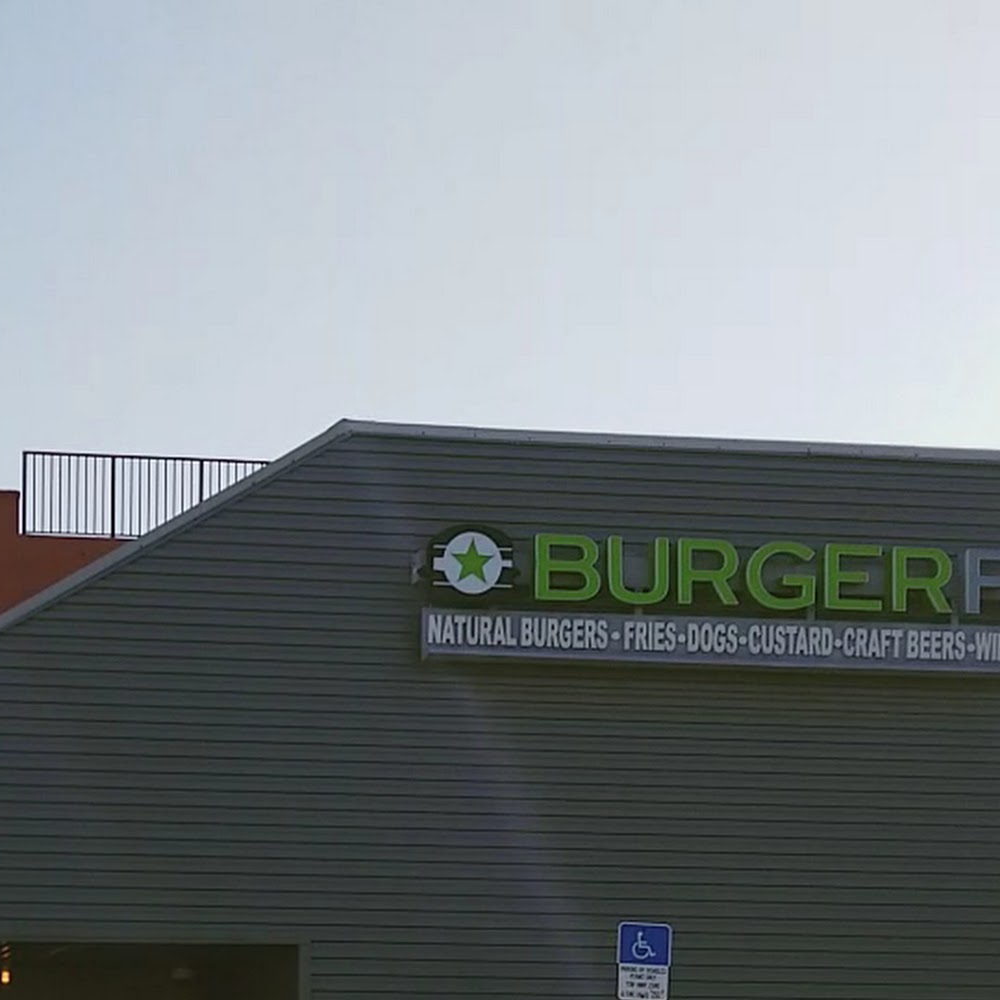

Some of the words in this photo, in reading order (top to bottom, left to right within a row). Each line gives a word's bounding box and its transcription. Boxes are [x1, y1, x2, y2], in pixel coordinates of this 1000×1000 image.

[428, 614, 517, 646] NATURAL
[520, 617, 608, 649] BURGERS
[624, 622, 676, 651] FRIES
[687, 623, 738, 653] DOGS
[750, 625, 833, 656] CUSTARD
[843, 628, 903, 657] CRAFT
[906, 630, 966, 660] BEERS
[975, 632, 1000, 661] WI
